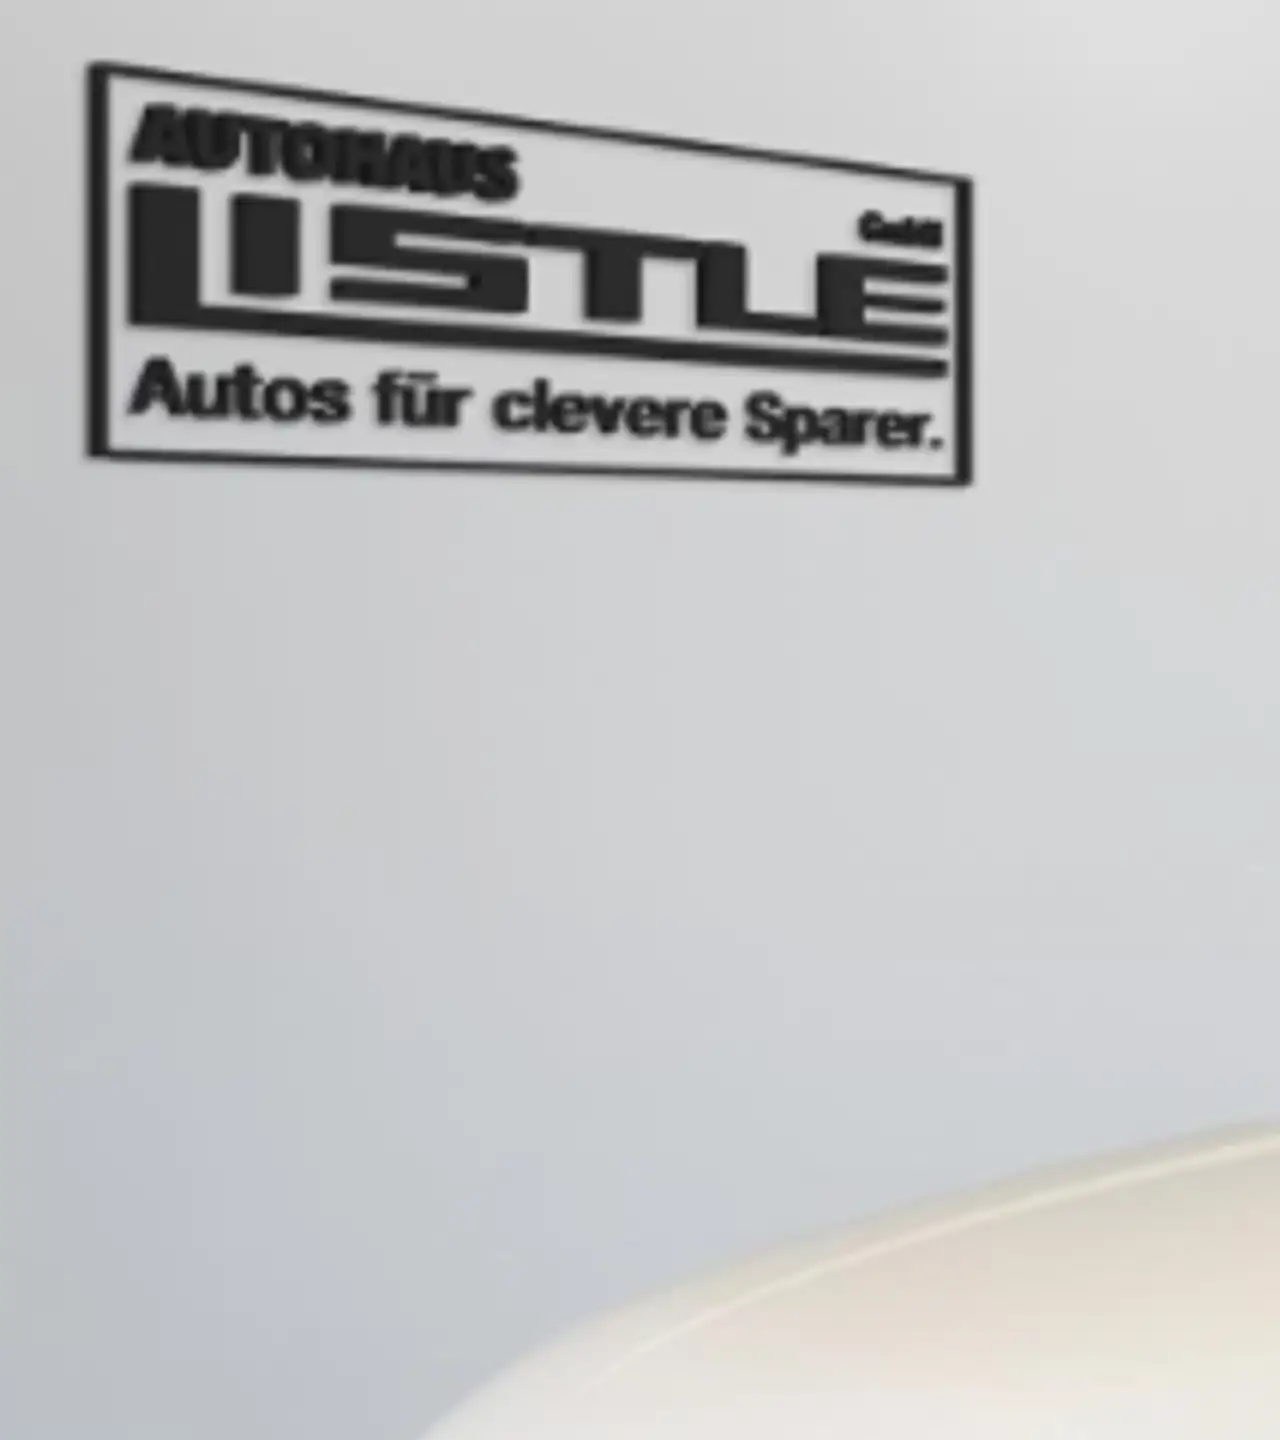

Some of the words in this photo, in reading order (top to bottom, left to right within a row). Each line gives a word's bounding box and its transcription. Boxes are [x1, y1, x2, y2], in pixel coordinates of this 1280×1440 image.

[128, 102, 519, 202] AUTOHAUS
[127, 355, 351, 426] Autos
[371, 369, 471, 430] für
[492, 377, 729, 439] clevere
[744, 389, 944, 456] Sparer.
